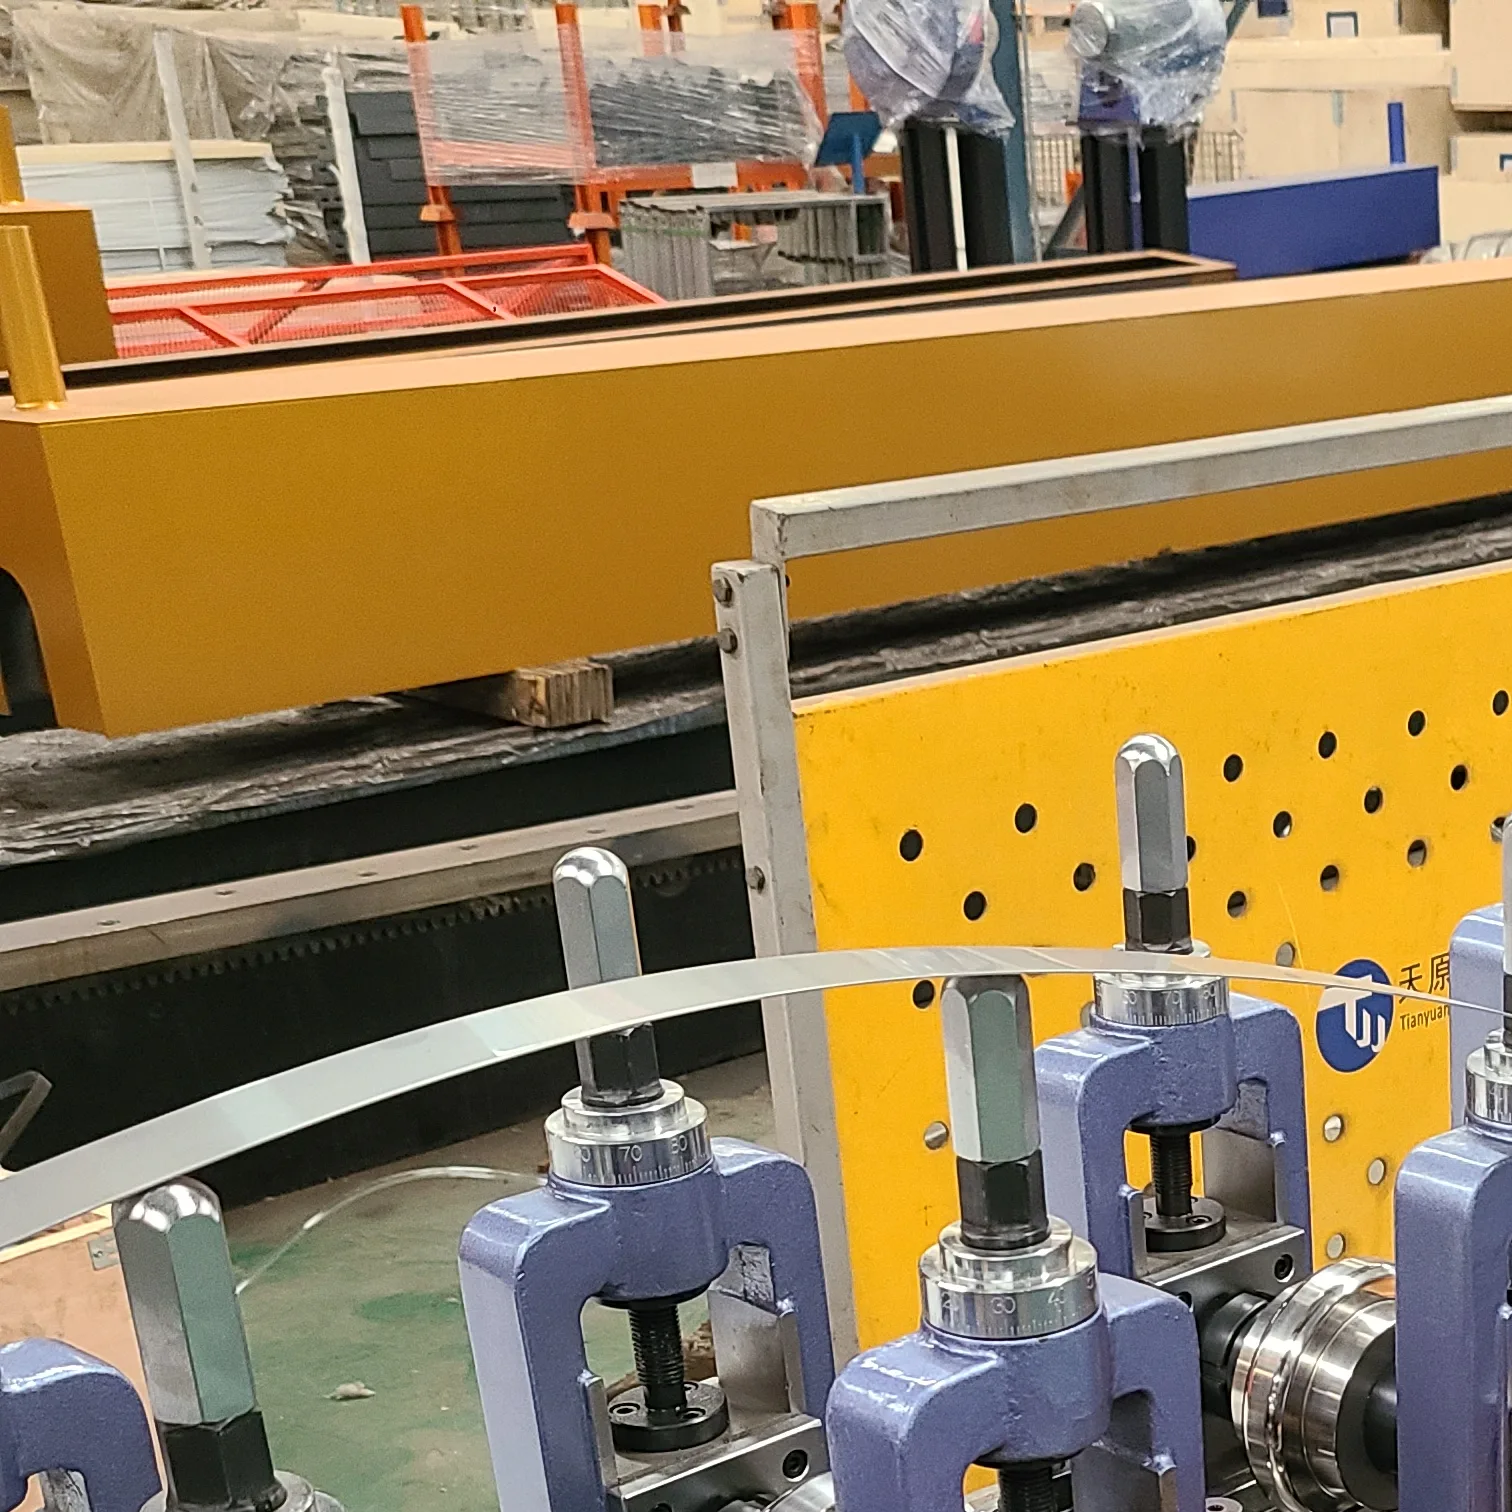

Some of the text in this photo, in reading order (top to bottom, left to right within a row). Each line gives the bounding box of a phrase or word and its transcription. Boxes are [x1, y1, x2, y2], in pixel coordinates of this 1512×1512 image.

[619, 1145, 643, 1163] 70
[670, 1135, 688, 1154] 80
[991, 1296, 1017, 1315] 30
